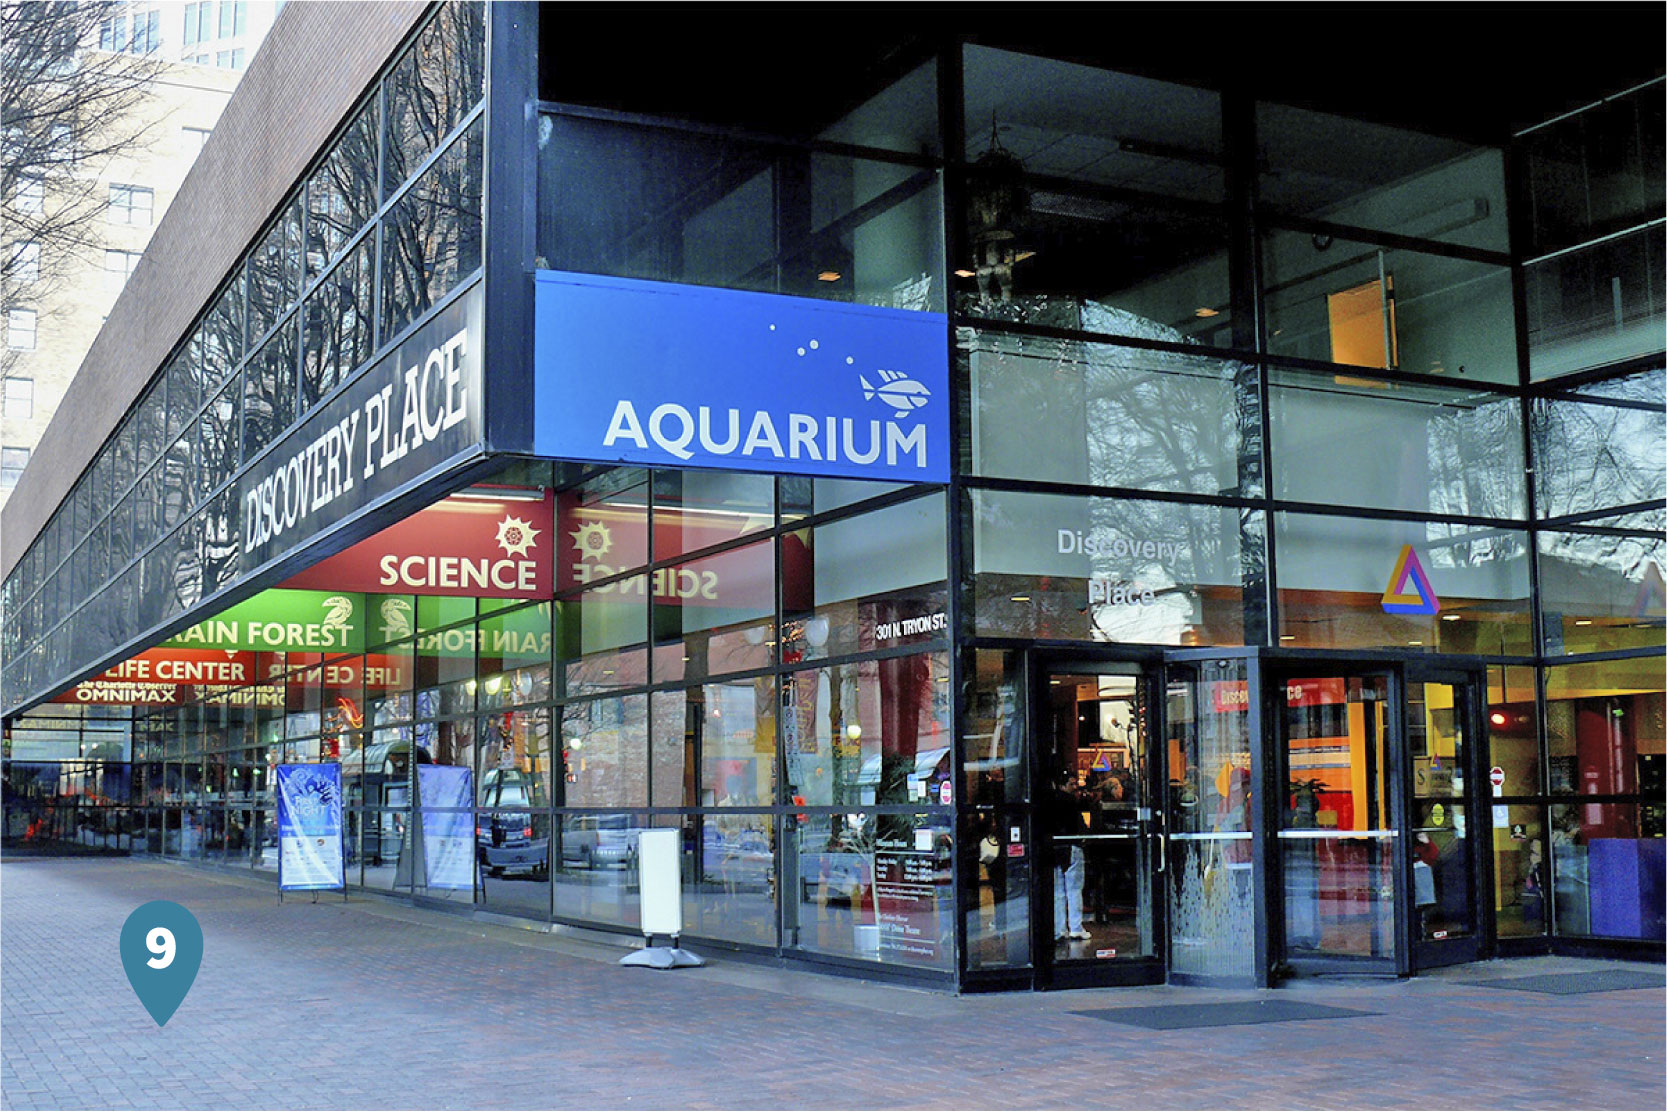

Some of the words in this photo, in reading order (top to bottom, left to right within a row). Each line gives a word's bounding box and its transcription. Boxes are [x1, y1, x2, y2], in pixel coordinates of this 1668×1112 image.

[245, 408, 360, 553] DISCOVERY
[363, 327, 468, 480] PLACE
[602, 399, 927, 468] AQUARIUM
[1057, 528, 1180, 566] Discovery
[380, 554, 537, 591] SCIENCE
[1088, 579, 1155, 606] Place
[248, 622, 354, 647] FOREST
[875, 623, 892, 640] 301
[892, 621, 902, 638] N.
[901, 614, 932, 636] TRYON
[932, 612, 948, 631] ST.
[155, 660, 245, 681] CENTER
[76, 688, 177, 703] OMNIMAX
